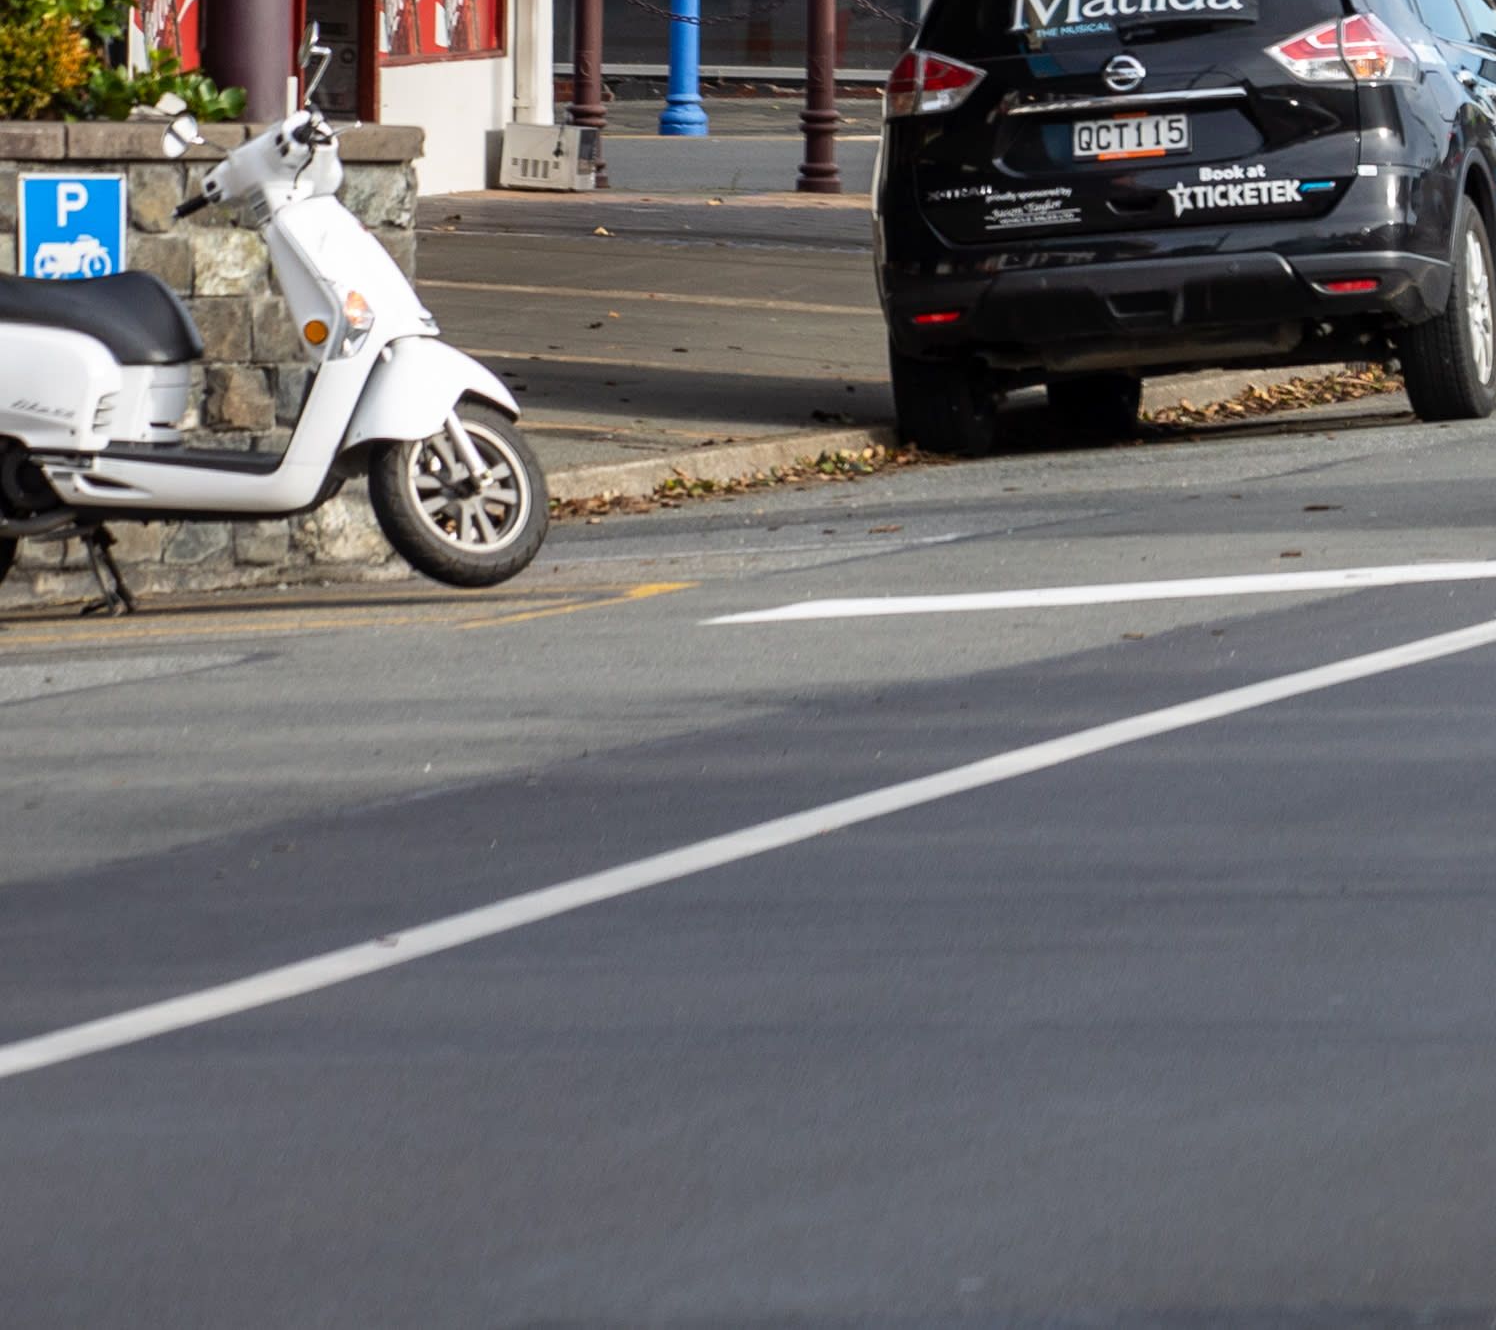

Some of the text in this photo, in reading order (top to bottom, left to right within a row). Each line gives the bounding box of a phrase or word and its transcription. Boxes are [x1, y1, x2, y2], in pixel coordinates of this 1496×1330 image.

[1061, 22, 1113, 36] MUSICAL
[1077, 118, 1185, 153] QCT115
[1200, 164, 1266, 182] Book at
[56, 182, 89, 228] P
[1193, 180, 1303, 209] TICKETEK
